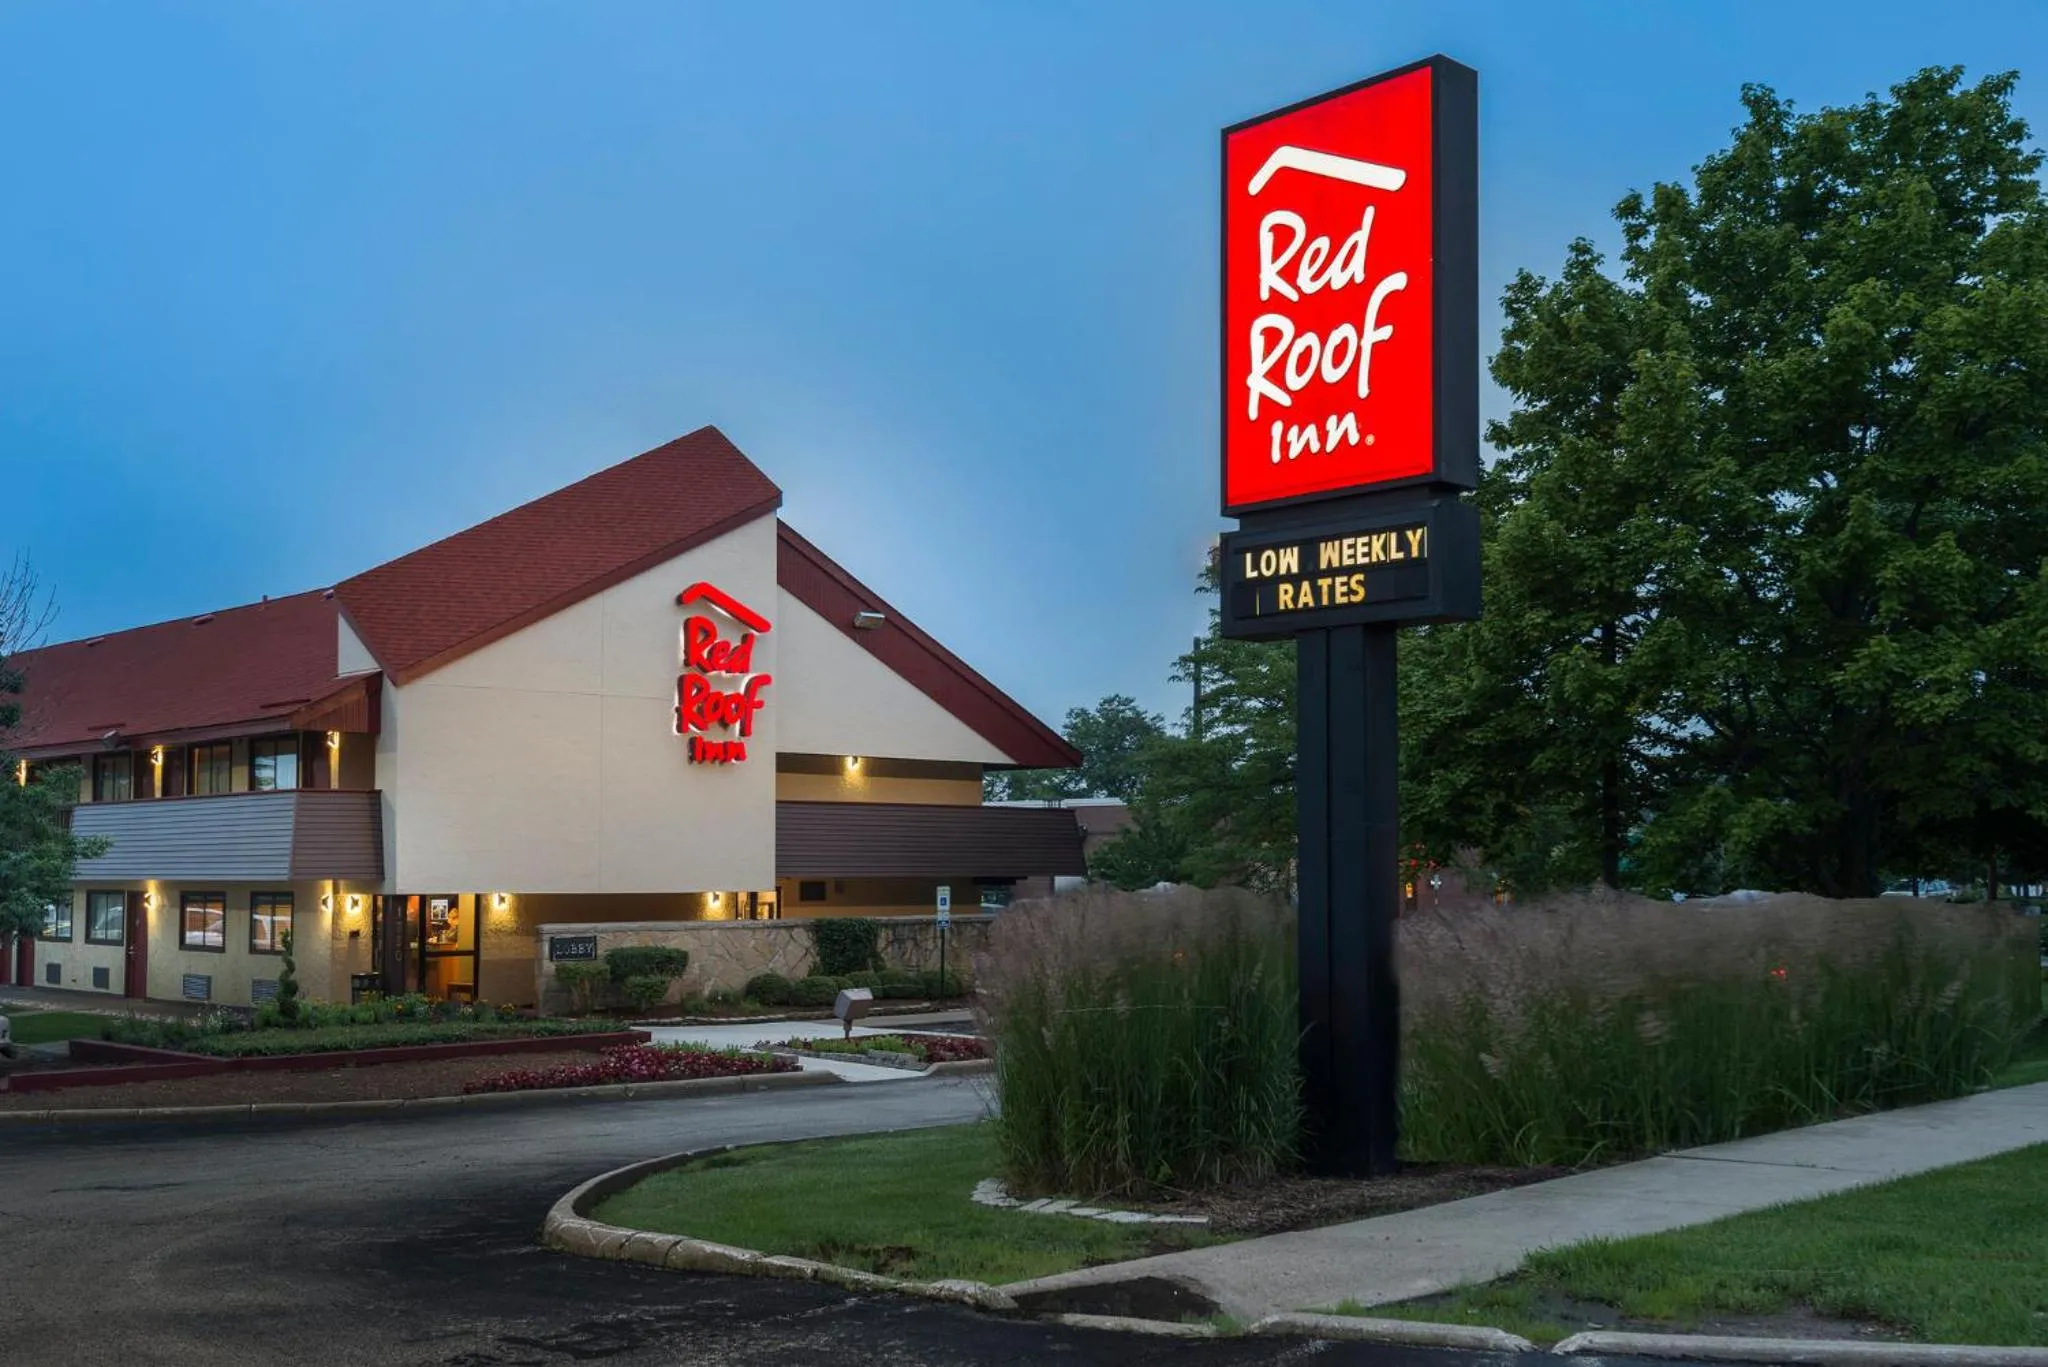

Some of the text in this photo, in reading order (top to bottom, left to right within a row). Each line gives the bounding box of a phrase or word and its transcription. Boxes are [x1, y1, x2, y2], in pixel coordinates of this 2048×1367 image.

[1259, 205, 1376, 302] Red
[1246, 271, 1408, 421] Roof
[1245, 527, 1424, 579] LOW WEEKLY
[1278, 573, 1366, 610] RATES
[683, 615, 756, 674] Red
[677, 672, 773, 737] Roof
